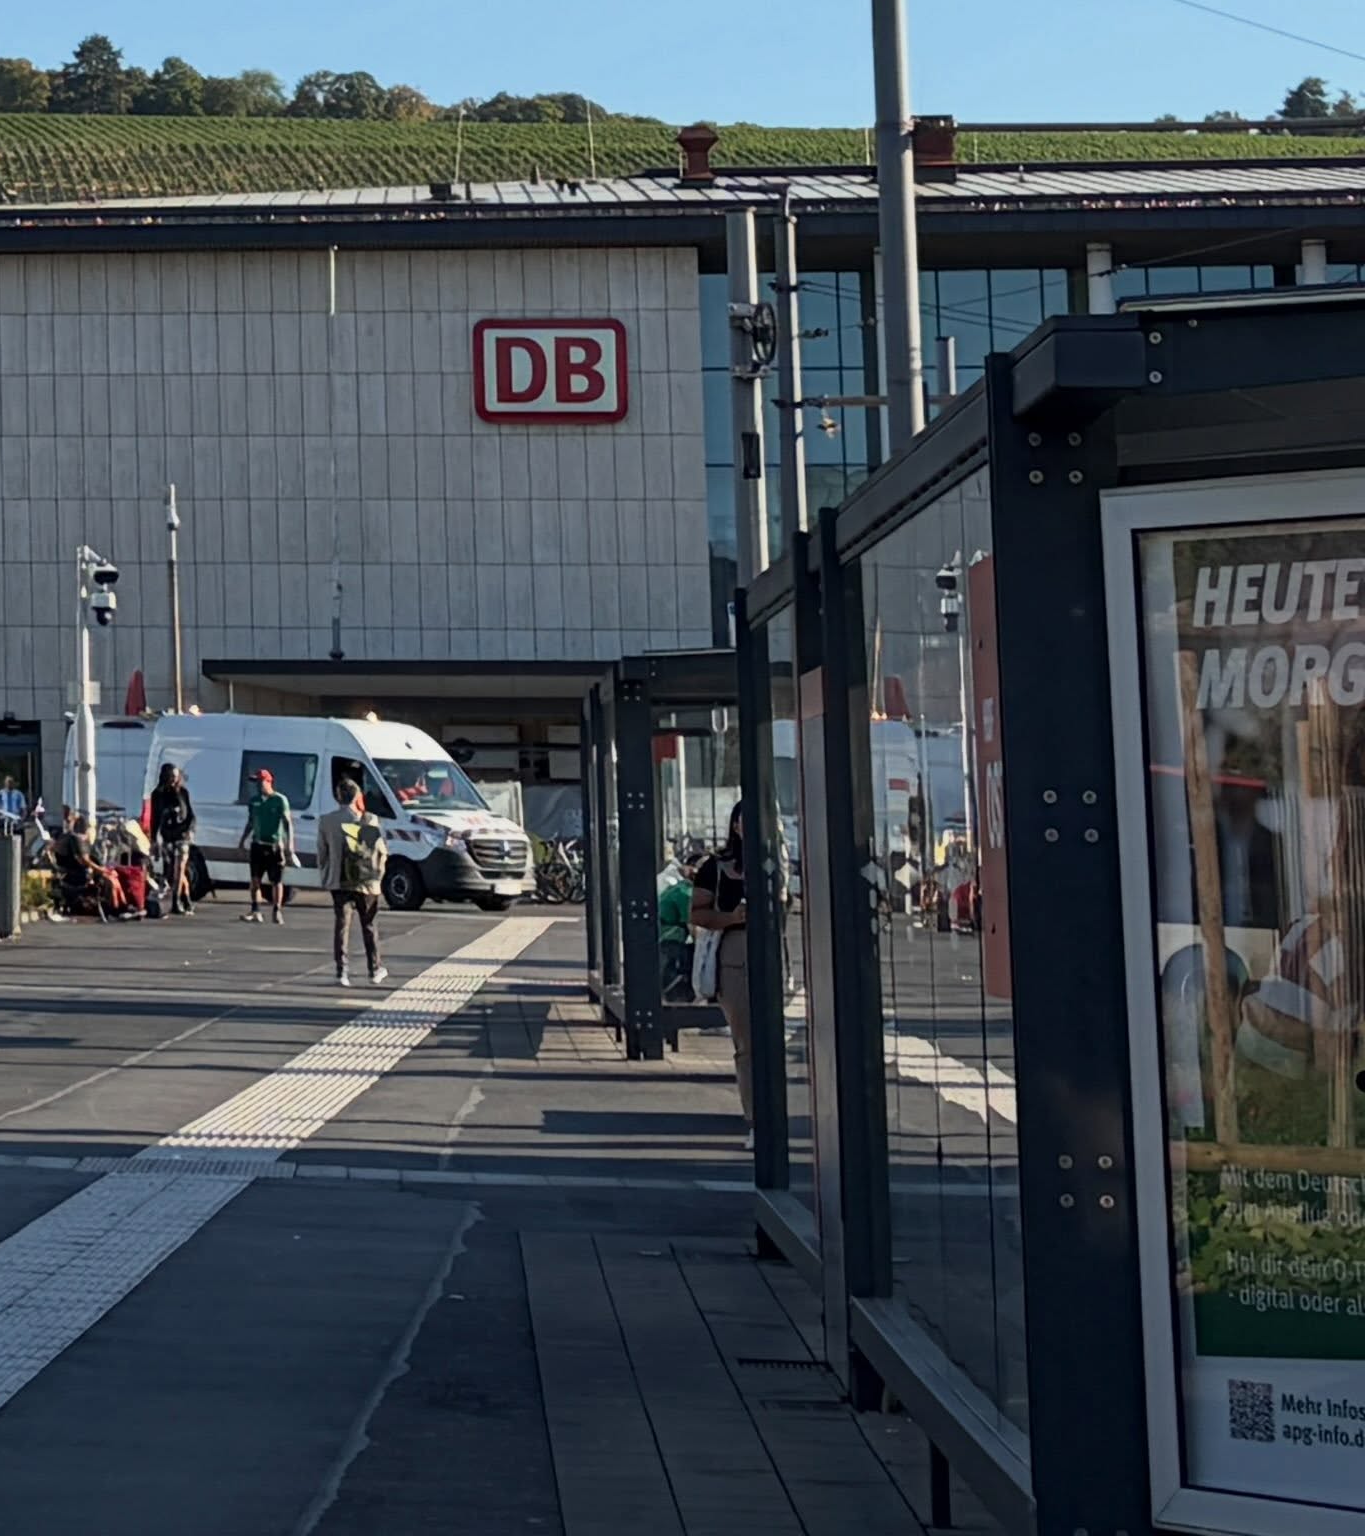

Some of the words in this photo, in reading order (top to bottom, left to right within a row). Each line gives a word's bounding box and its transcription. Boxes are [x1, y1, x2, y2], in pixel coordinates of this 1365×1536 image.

[495, 336, 606, 403] DB
[1193, 558, 1365, 628] HEUTE
[1195, 642, 1365, 709] MORG
[1219, 1164, 1251, 1188] Mit
[1254, 1167, 1294, 1192] dem
[1226, 1250, 1256, 1275] Hol
[1240, 1287, 1295, 1313] digital
[1300, 1292, 1342, 1313] oder
[1346, 1295, 1365, 1317] al
[1281, 1392, 1322, 1415] Mehr
[1327, 1398, 1365, 1421] Infos
